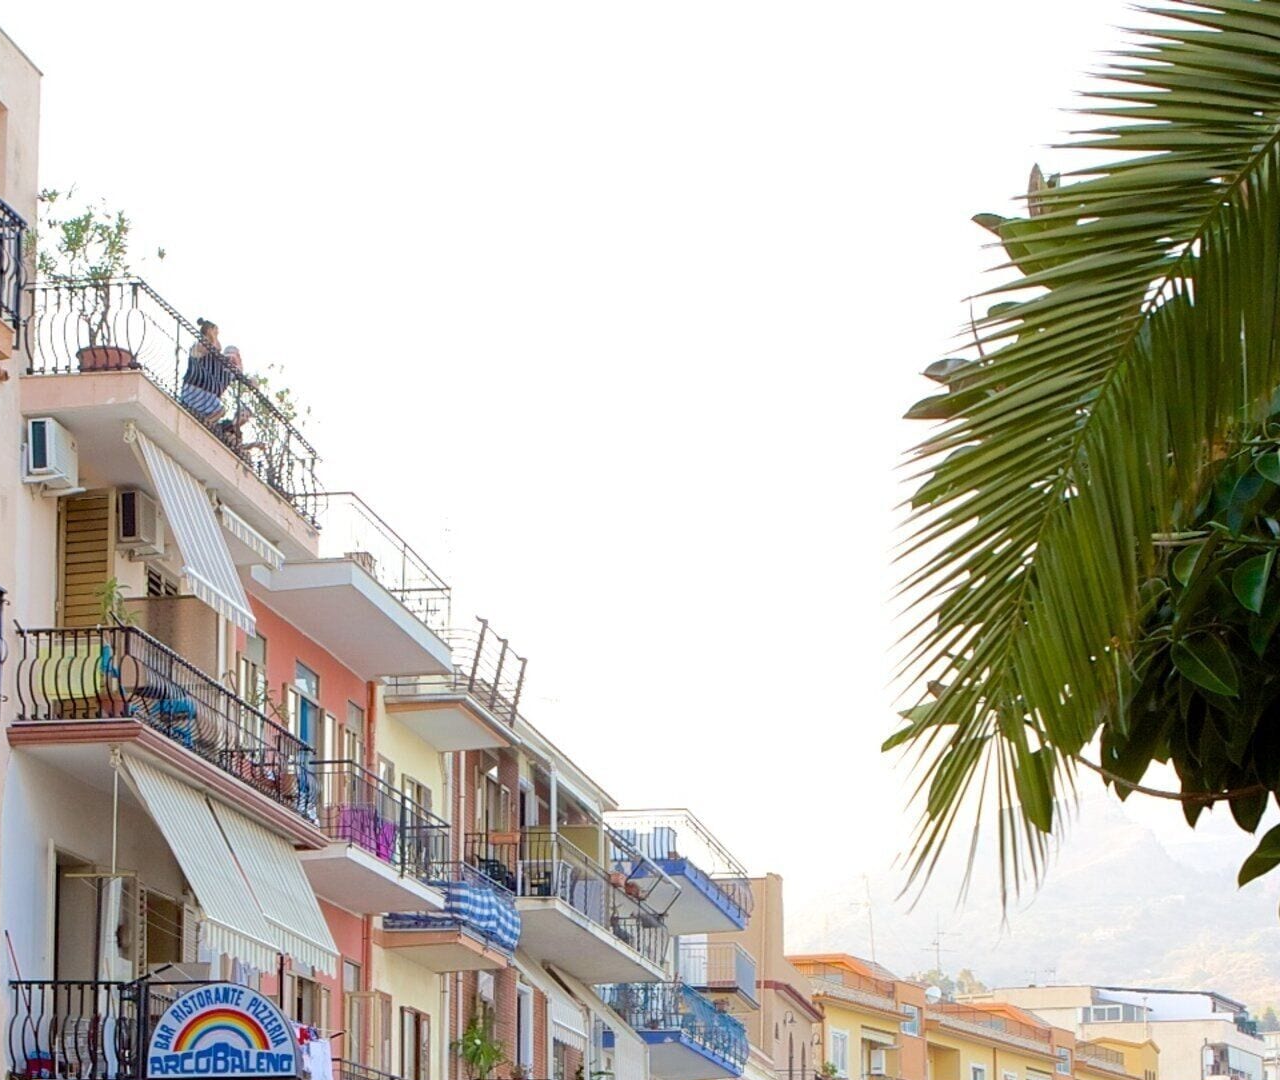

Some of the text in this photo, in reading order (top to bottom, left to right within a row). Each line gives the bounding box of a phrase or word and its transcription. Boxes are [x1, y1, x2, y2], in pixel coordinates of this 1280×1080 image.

[153, 986, 289, 1051] BAR RISTORANTE PIZZERIA
[150, 1042, 293, 1075] ARCOBALENO
